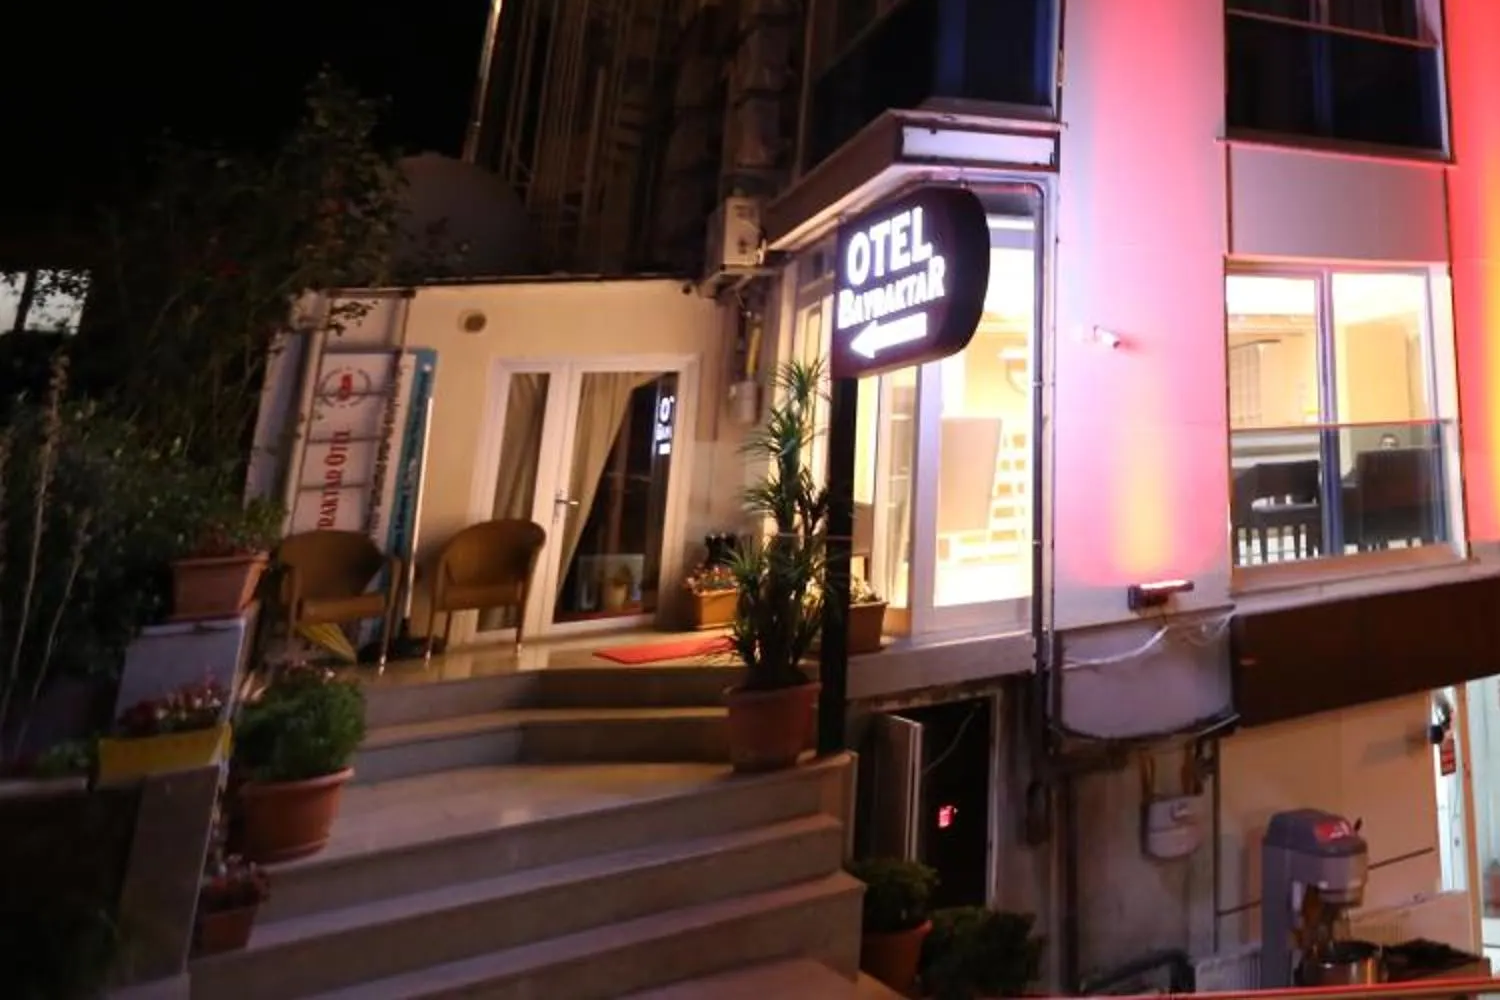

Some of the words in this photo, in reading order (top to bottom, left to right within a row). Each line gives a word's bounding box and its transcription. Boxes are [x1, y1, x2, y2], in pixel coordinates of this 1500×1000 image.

[846, 206, 933, 286] OTEL
[837, 255, 947, 330] BAYRAKTAR
[317, 471, 342, 530] RAKTAR
